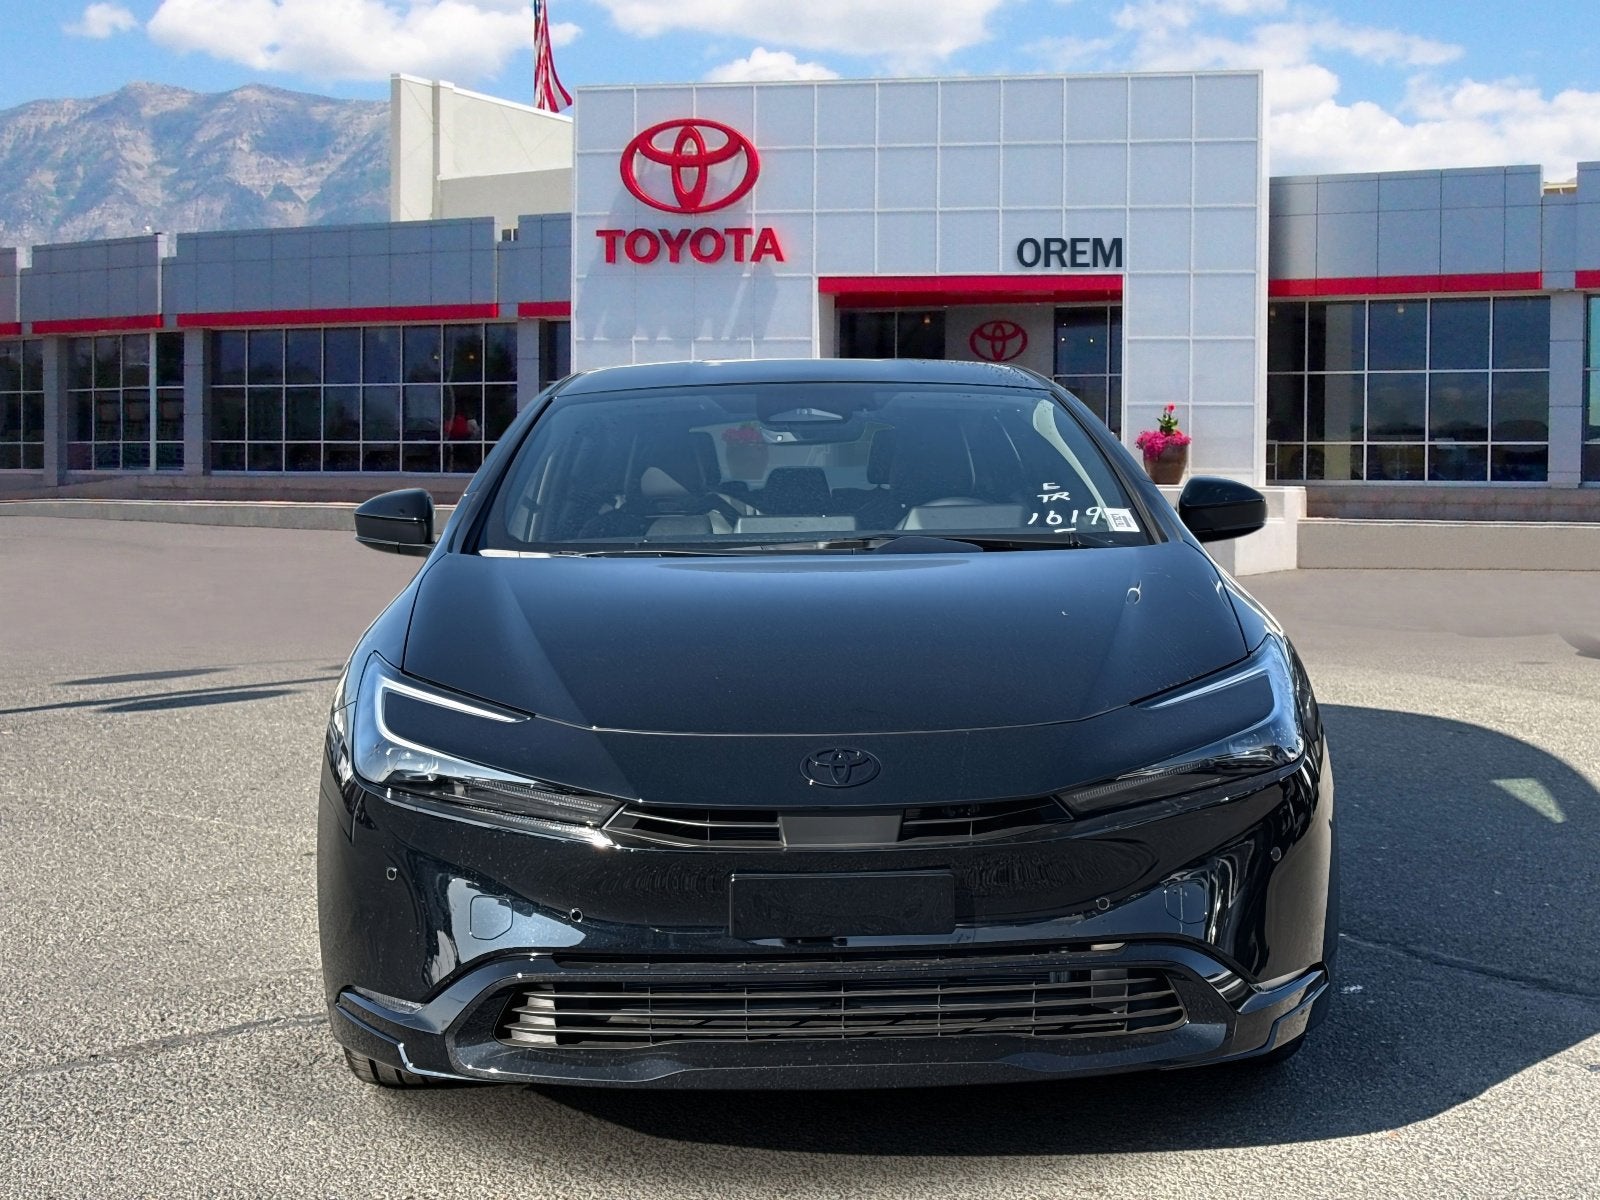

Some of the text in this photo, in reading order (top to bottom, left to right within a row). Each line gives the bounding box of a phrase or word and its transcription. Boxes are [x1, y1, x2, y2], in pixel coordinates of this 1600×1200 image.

[596, 227, 785, 265] TOYOTA
[1017, 237, 1123, 268] OREM
[1027, 506, 1103, 526] 1619
